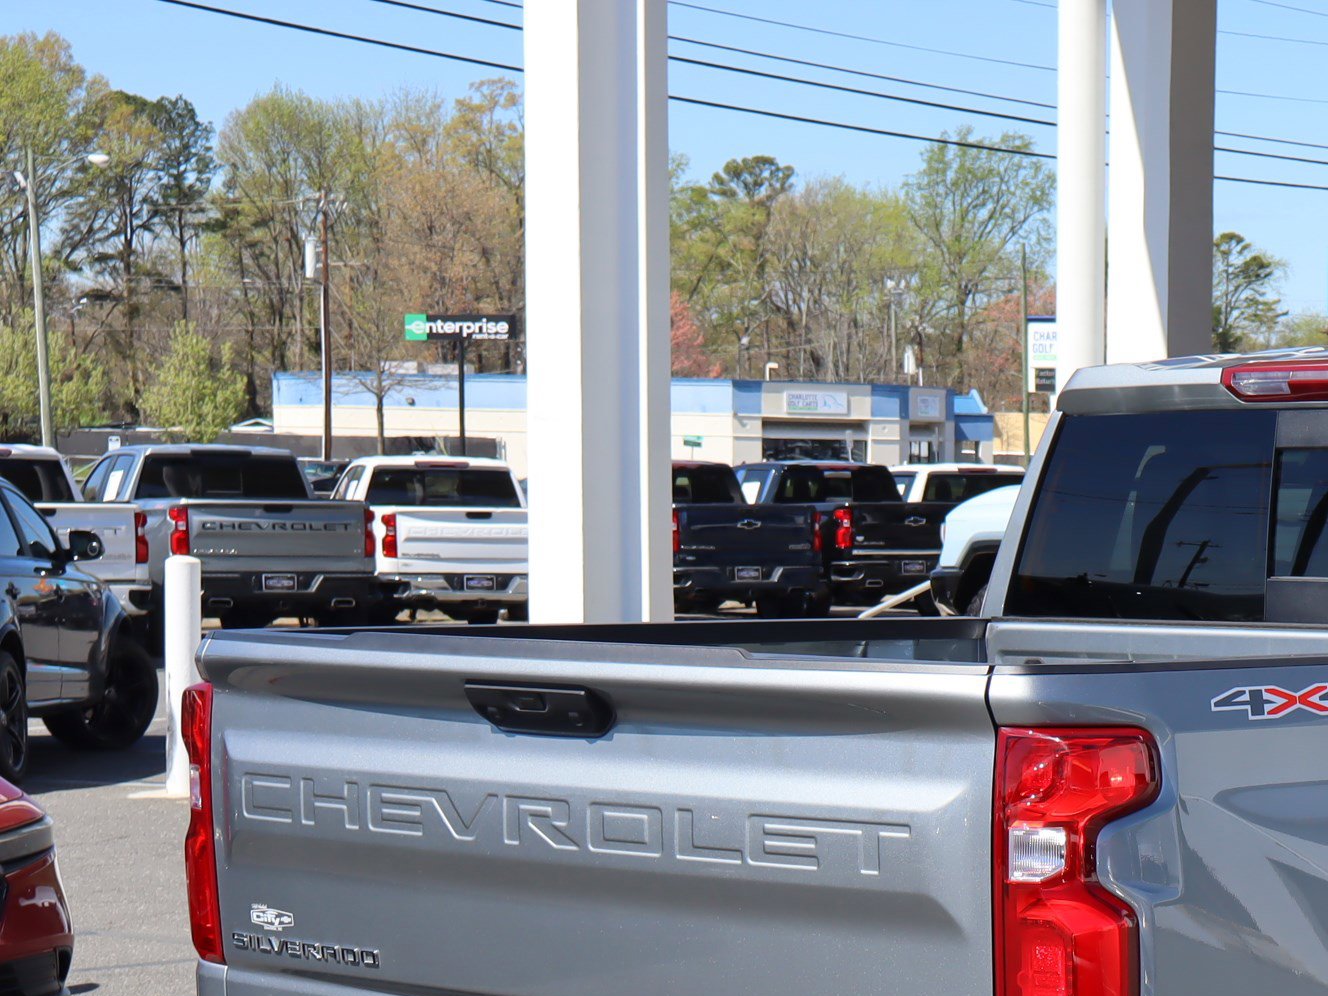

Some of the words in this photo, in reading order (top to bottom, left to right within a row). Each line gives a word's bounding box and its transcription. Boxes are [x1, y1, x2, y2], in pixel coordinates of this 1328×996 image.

[411, 318, 509, 337] enterprise
[201, 520, 354, 532] CHEVROLET
[408, 527, 528, 537] CHEVROL
[240, 773, 912, 875] CHEVROLET
[232, 932, 381, 968] SILVERADO
